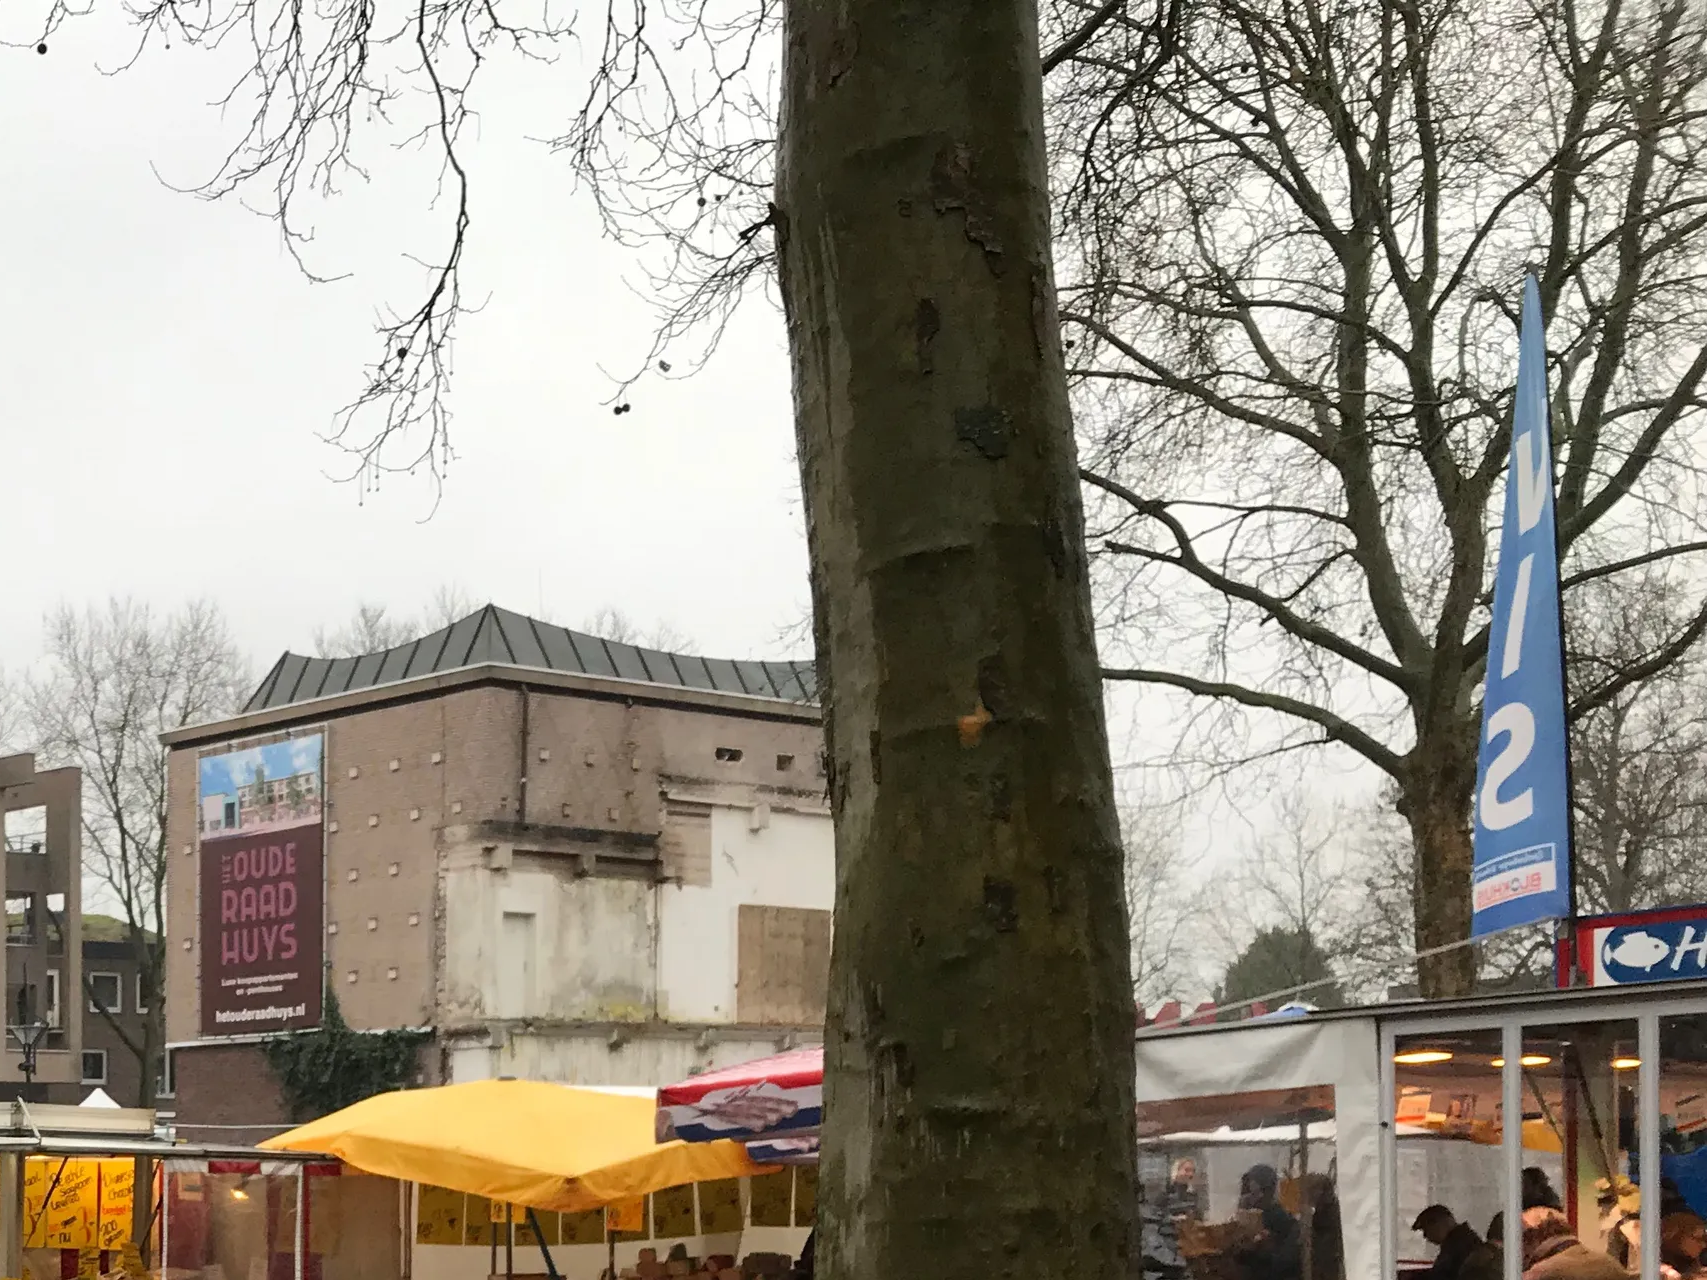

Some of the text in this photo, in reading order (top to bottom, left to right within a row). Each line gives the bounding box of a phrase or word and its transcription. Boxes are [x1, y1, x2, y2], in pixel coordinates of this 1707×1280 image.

[234, 842, 296, 881] OUDE
[221, 881, 298, 924] RAAD
[221, 923, 298, 966] HUYS
